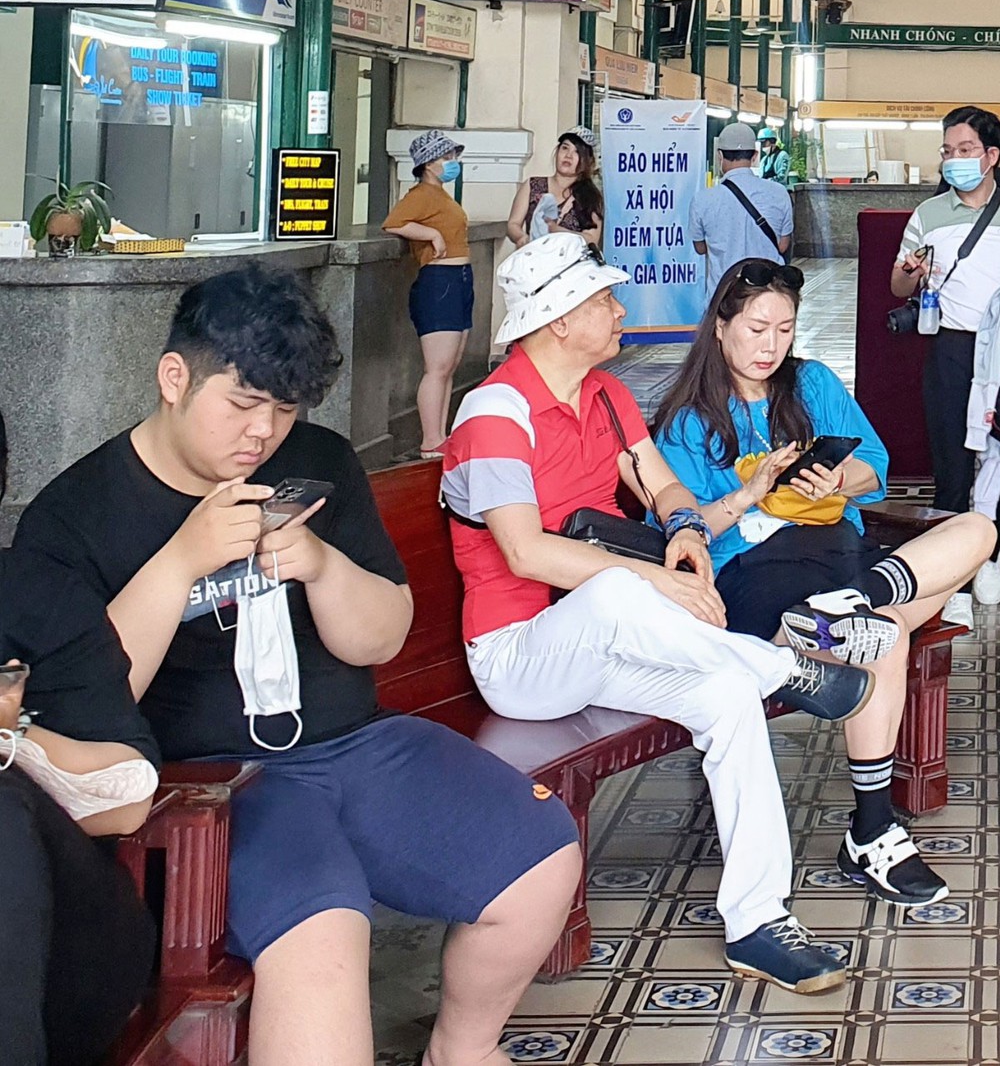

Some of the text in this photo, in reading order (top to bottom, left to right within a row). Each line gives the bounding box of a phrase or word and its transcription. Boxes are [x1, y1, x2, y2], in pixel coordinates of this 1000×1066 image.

[850, 29, 900, 40] NHANH
[905, 27, 956, 42] CHÓNG
[131, 47, 217, 67] DAILY TOUR BOOKING
[131, 66, 149, 82] BUS
[191, 71, 216, 87] TRAIN
[147, 89, 172, 105] SHOW
[618, 142, 688, 172] BẢO HIỂM
[625, 184, 674, 213] XÃ HỘI
[614, 216, 684, 250] ĐIỂM TỰA
[634, 264, 657, 284] GIA
[662, 259, 696, 284] ĐÌNH
